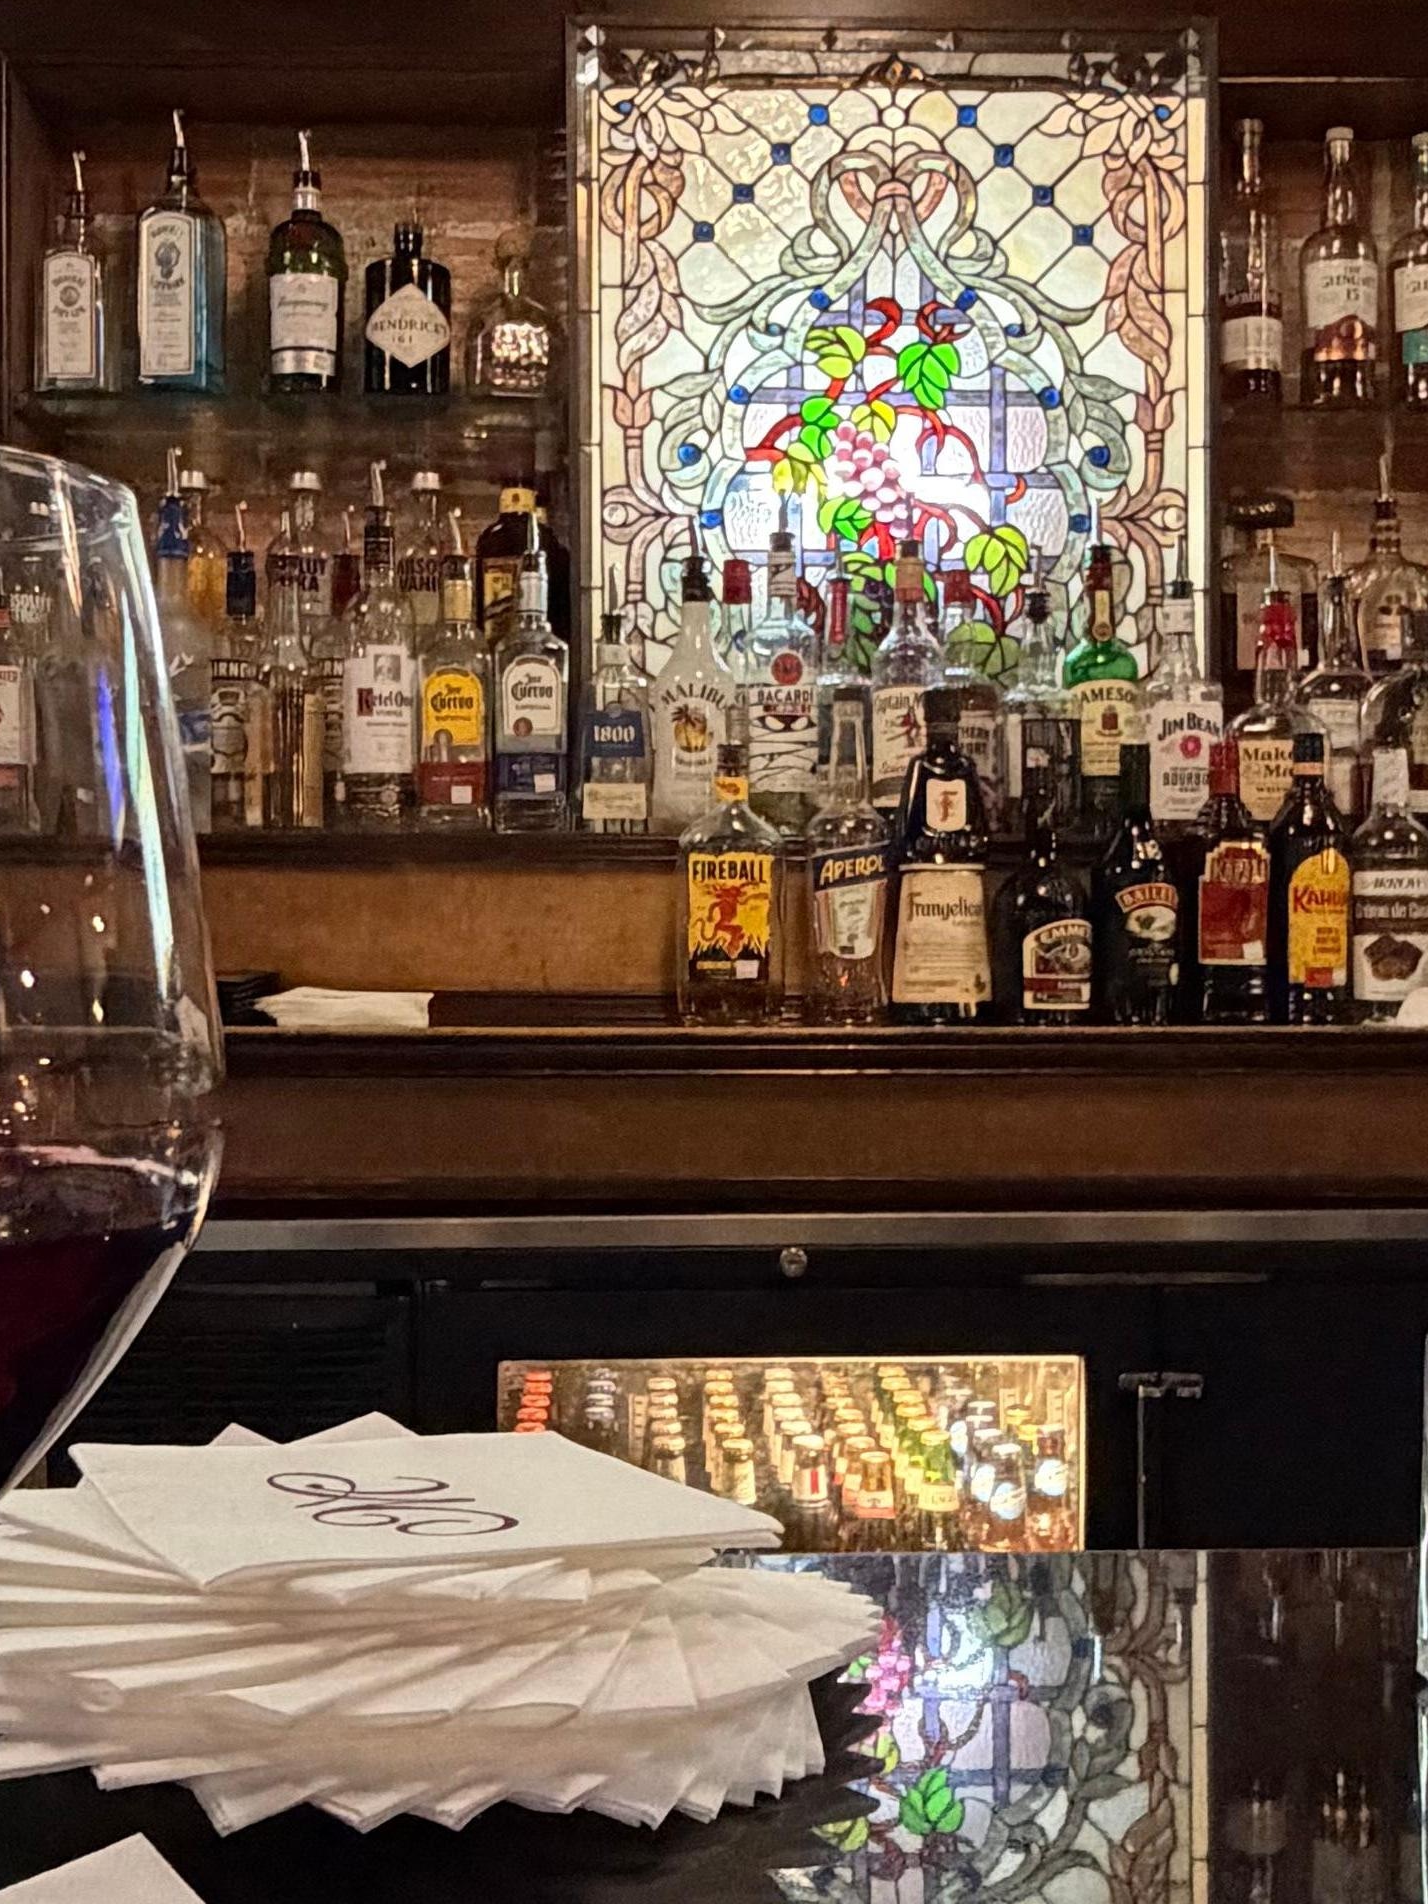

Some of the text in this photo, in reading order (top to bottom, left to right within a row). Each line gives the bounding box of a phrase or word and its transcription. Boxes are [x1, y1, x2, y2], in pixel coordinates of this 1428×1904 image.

[660, 682, 726, 710] MALIBU
[592, 724, 635, 745] 1800
[691, 859, 767, 884] FIREBALL
[819, 854, 885, 887] APEROL
